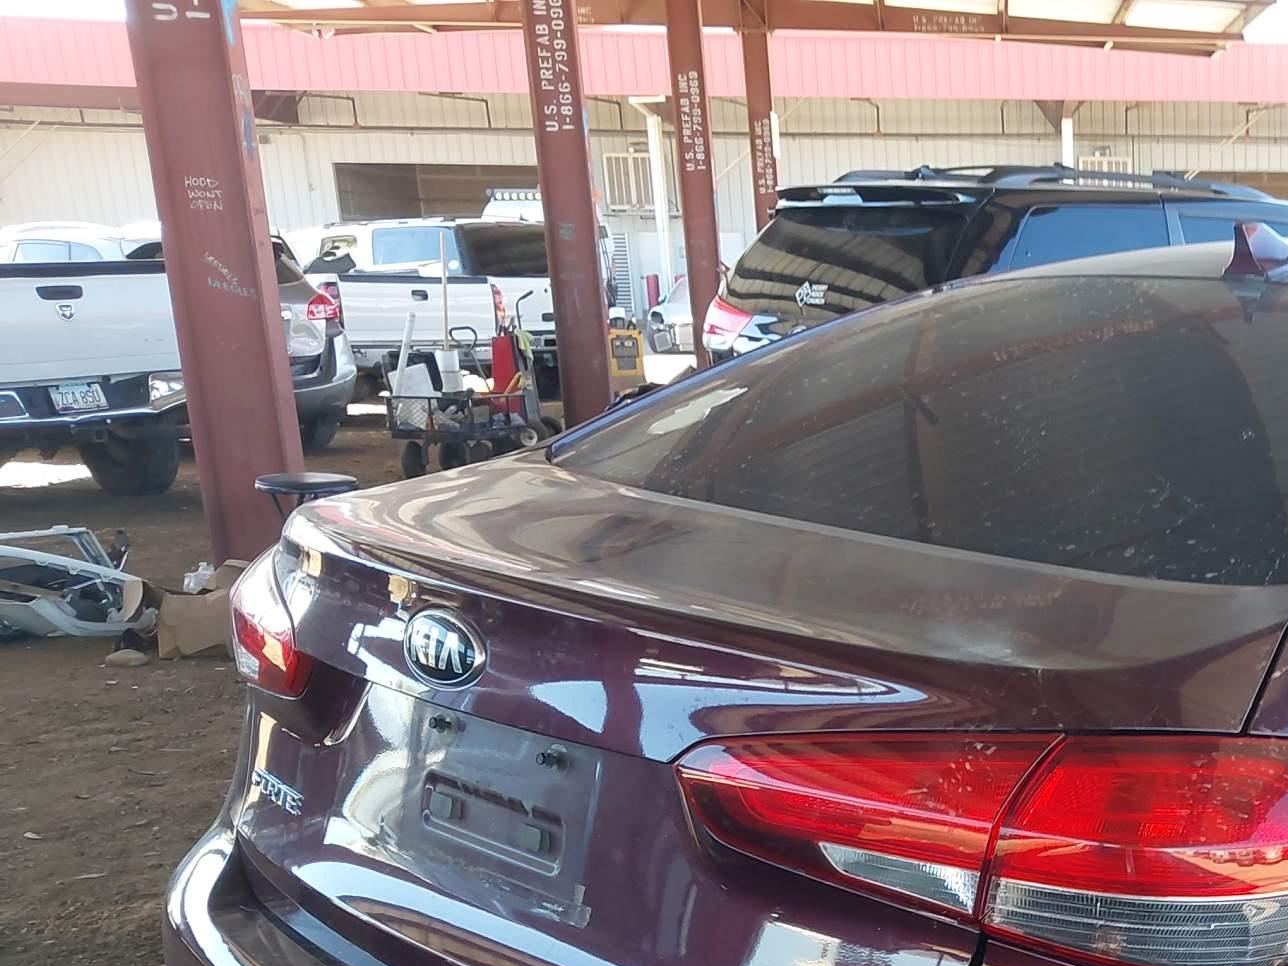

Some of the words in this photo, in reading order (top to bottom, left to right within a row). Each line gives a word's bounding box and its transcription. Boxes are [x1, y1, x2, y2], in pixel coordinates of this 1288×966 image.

[535, 23, 556, 91] PREFAB
[549, 0, 575, 131] 1-866-799-096
[678, 73, 689, 94] INC
[544, 99, 559, 132] U.S.
[679, 98, 693, 143] PREFAB
[410, 622, 463, 674] KIA
